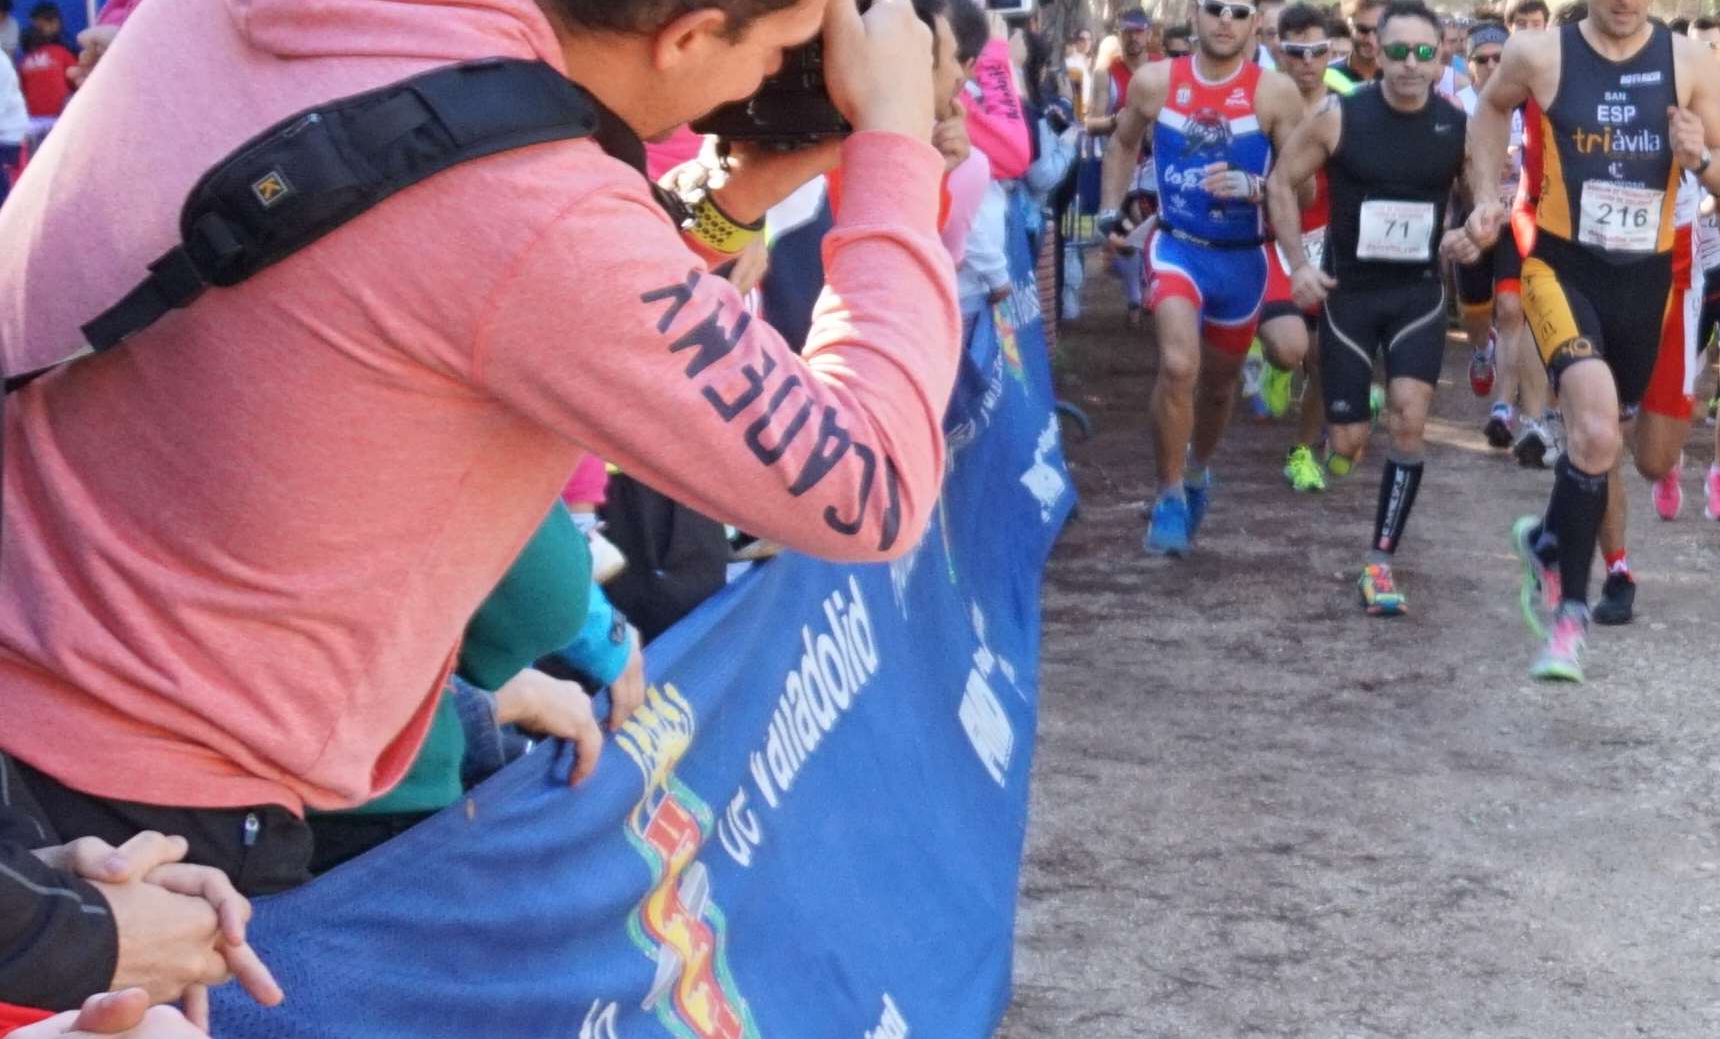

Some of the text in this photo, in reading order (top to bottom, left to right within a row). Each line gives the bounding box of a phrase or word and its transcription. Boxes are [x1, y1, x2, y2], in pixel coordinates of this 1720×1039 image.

[1597, 105, 1637, 123] ESP
[1596, 202, 1649, 228] 216
[1385, 219, 1410, 240] 71
